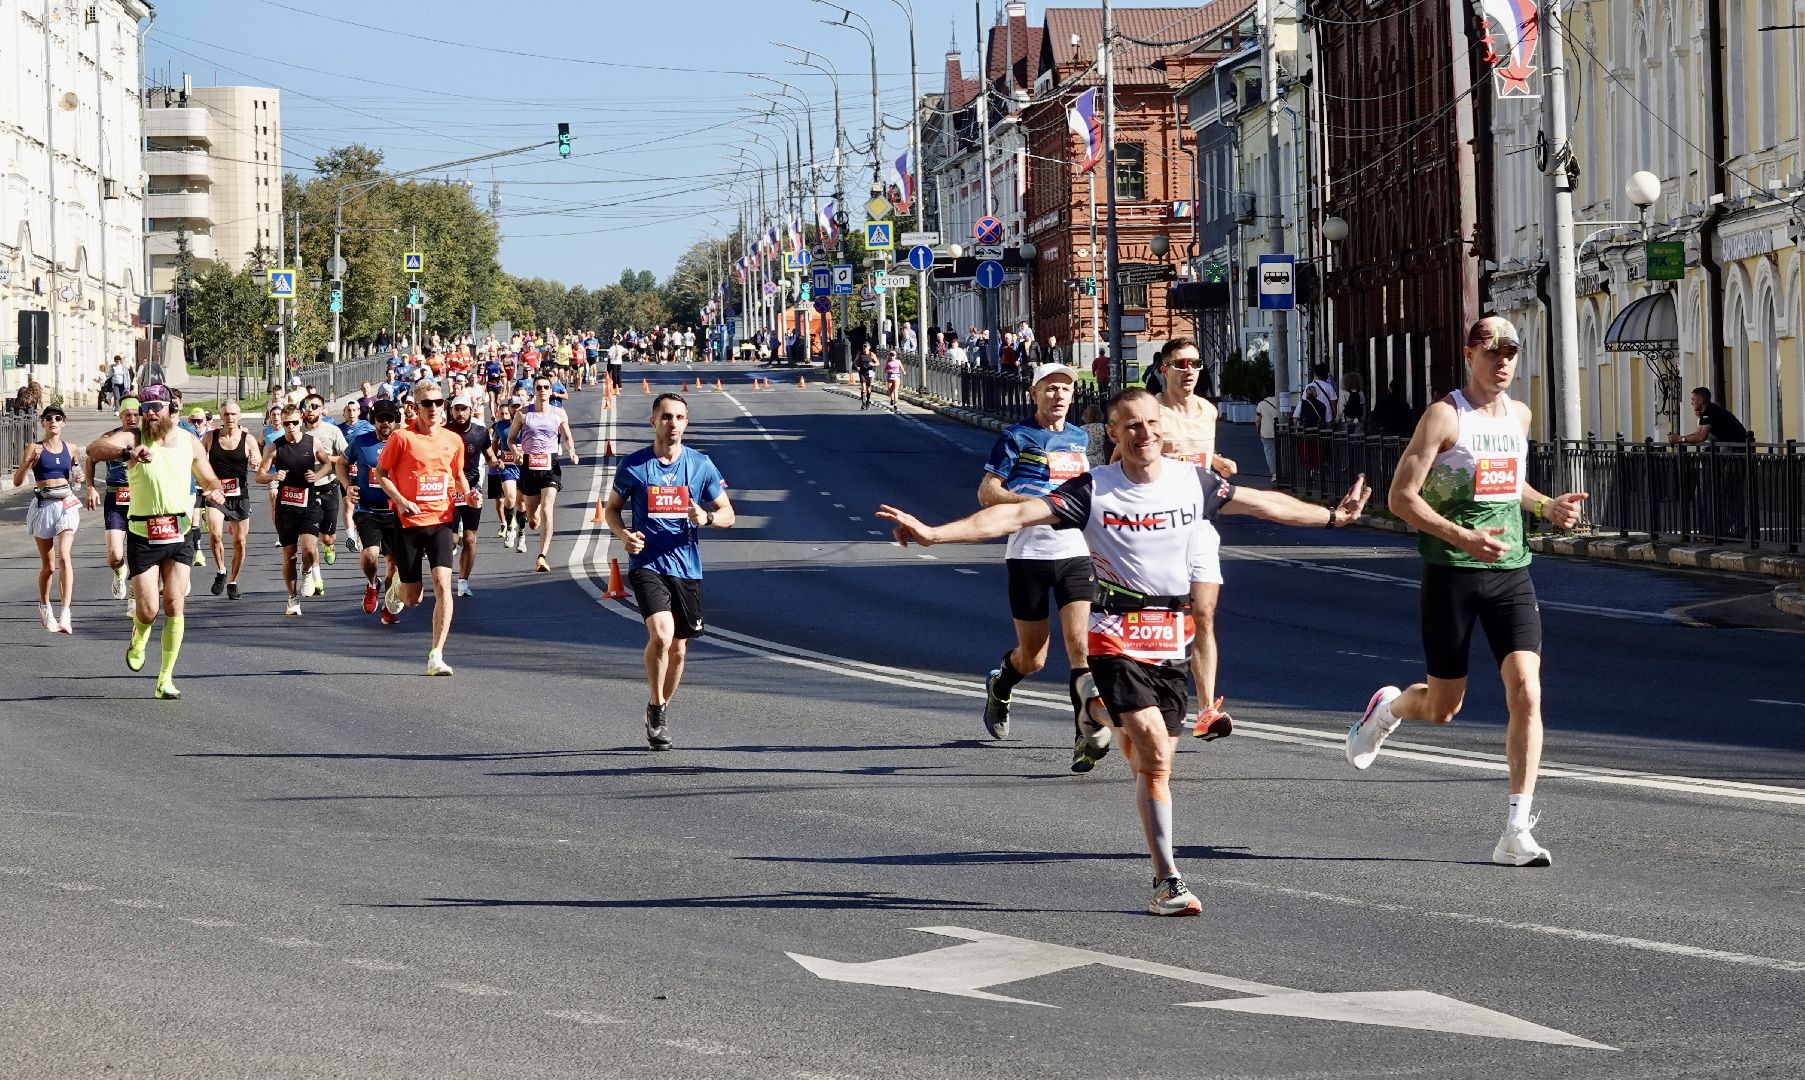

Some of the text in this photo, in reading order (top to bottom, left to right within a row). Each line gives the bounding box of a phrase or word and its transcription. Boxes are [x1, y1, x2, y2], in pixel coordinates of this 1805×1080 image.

[881, 277, 905, 286] СТОП
[1480, 470, 1515, 485] 2094
[420, 482, 443, 491] 2009
[655, 495, 683, 506] 2114
[1103, 503, 1197, 532] РАКЕТЫ
[1128, 625, 1174, 640] 2078
